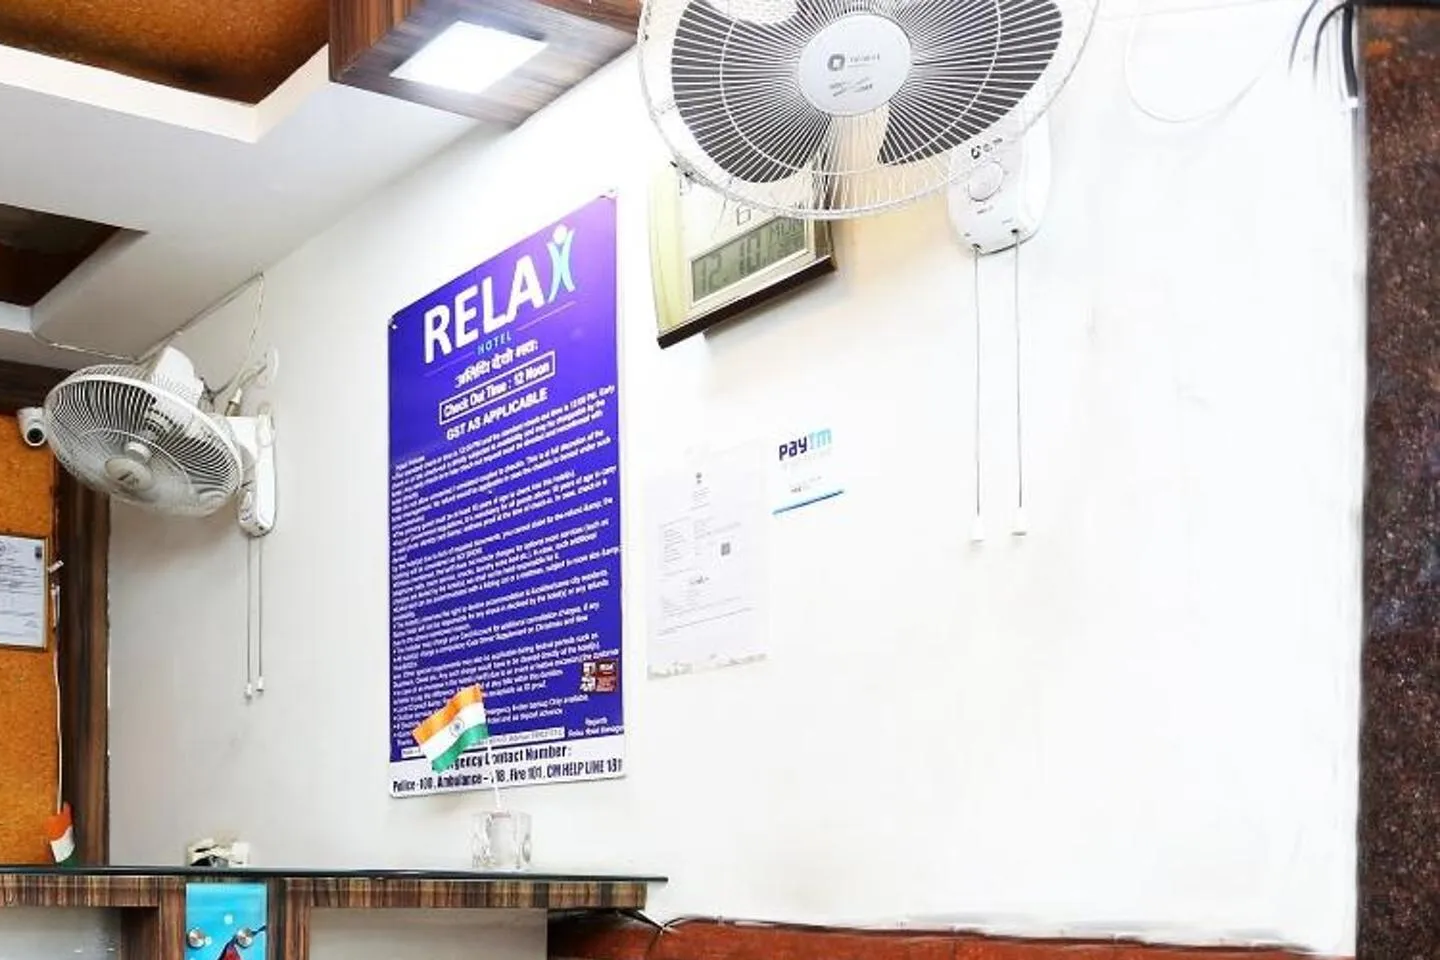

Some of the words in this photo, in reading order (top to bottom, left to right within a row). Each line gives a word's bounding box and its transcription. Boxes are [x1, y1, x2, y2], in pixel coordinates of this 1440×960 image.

[424, 224, 576, 364] RELAX
[477, 331, 512, 356] HOTEL
[443, 396, 469, 418] Check
[470, 389, 486, 407] Out
[486, 381, 508, 399] Time
[525, 361, 550, 382] Noon
[467, 415, 481, 433] AS
[482, 386, 549, 426] APPLICABLE
[562, 761, 585, 776] HELP
